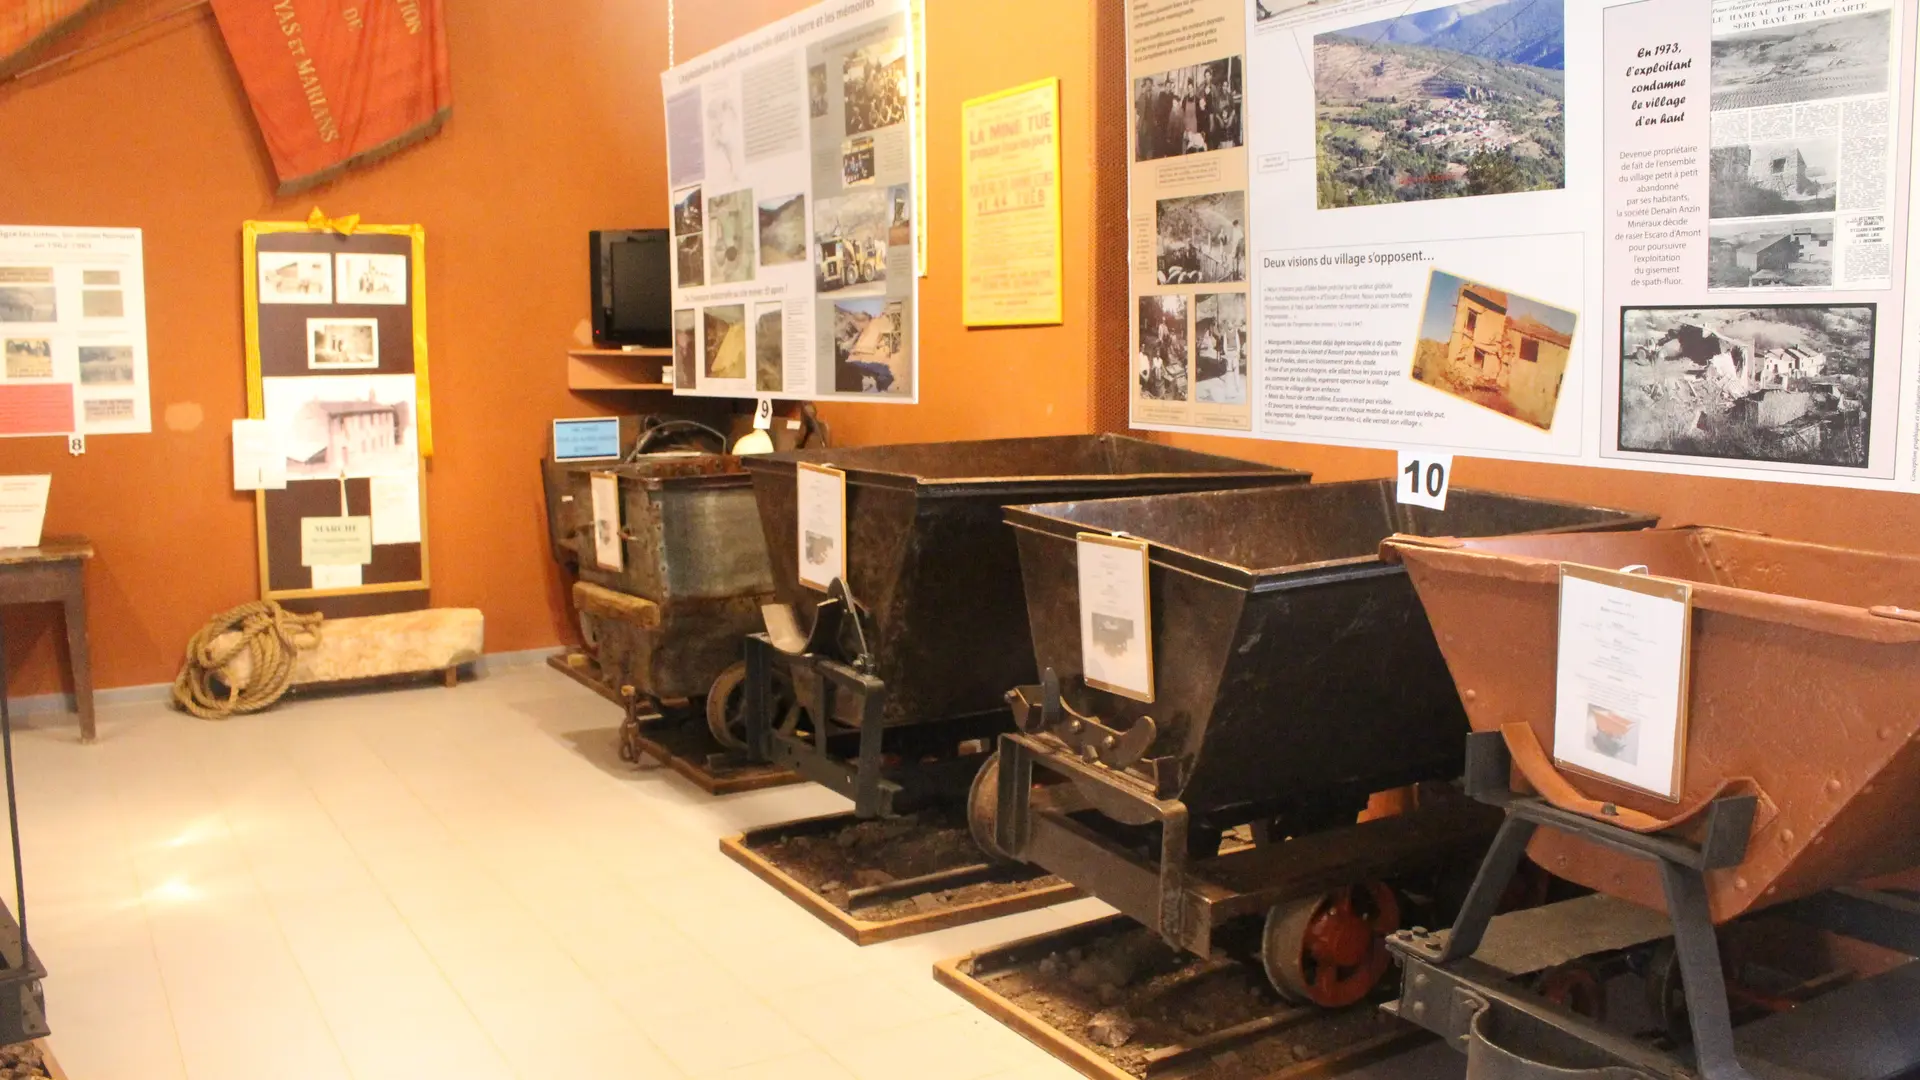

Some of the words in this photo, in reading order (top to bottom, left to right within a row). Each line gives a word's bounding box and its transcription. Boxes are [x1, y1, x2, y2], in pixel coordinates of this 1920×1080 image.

[1730, 9, 1771, 21] HAMEAU
[1794, 12, 1807, 20] DE
[1833, 2, 1868, 14] CARTE
[816, 16, 823, 28] et
[825, 12, 835, 24] les
[1638, 48, 1651, 58] En
[1655, 42, 1681, 55] 1973,
[1626, 58, 1692, 76] l'exploitant
[1632, 79, 1686, 93] condamne
[297, 58, 339, 143] MARIANS
[1632, 100, 1642, 110] le
[1646, 96, 1686, 108] village
[1635, 116, 1656, 126] d'en
[1660, 112, 1684, 123] haut
[970, 128, 984, 145] LA
[1027, 111, 1052, 132] TUE
[1619, 150, 1652, 159] Devenue
[1653, 145, 1698, 156] propriétaire
[1656, 157, 1696, 167] l'ensemble
[1630, 173, 1653, 182] village
[1655, 171, 1672, 180] petit
[1680, 169, 1698, 179] petit
[1637, 183, 1679, 192] abandonné
[1624, 208, 1649, 217] société
[1651, 207, 1677, 215] Denain
[1663, 218, 1688, 226] décide
[1647, 242, 1686, 251] poursuivre
[1264, 257, 1285, 268] Deux
[1287, 255, 1318, 268] visions
[1320, 254, 1332, 266] du
[1334, 253, 1366, 268] village
[1634, 254, 1680, 264] l'exploitation
[1646, 266, 1680, 275] gisement
[761, 400, 769, 418] 9
[72, 438, 82, 451] 8
[1404, 460, 1444, 497] 10
